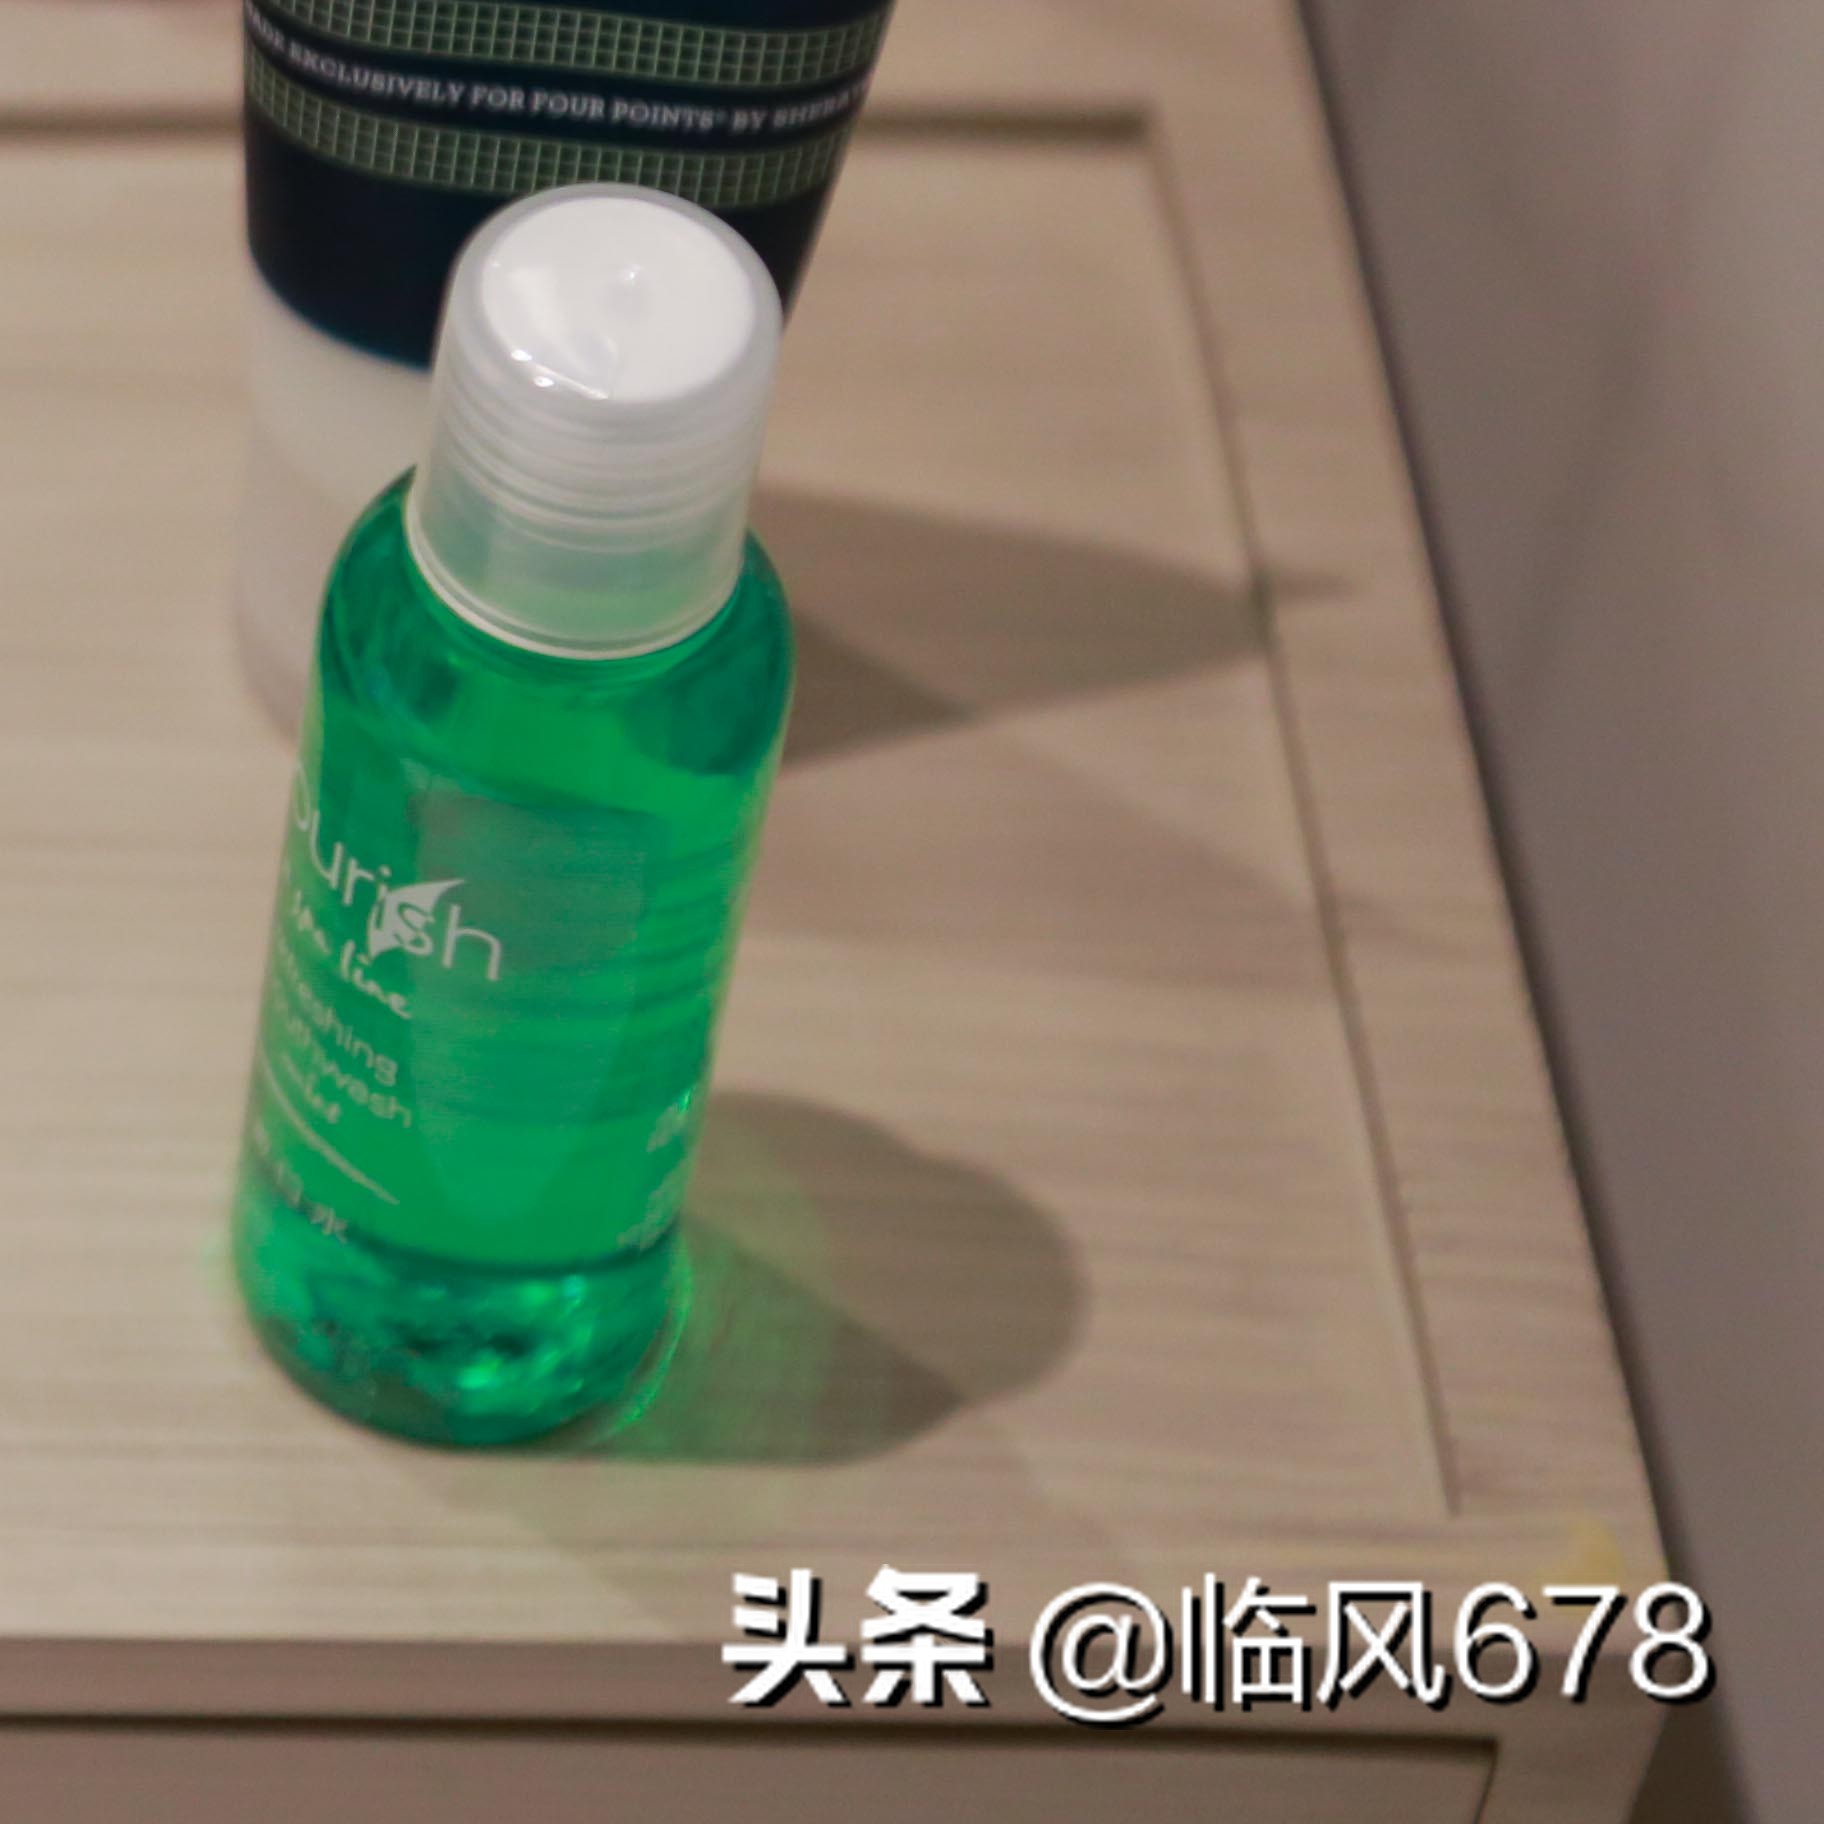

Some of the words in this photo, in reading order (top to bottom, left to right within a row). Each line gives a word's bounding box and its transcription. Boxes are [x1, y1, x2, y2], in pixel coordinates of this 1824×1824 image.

[289, 39, 466, 105] EXCLUSIVELY
[469, 83, 527, 112] FOR
[529, 90, 605, 119] FOUR
[729, 108, 767, 133] BY
[295, 760, 502, 982] ourish
